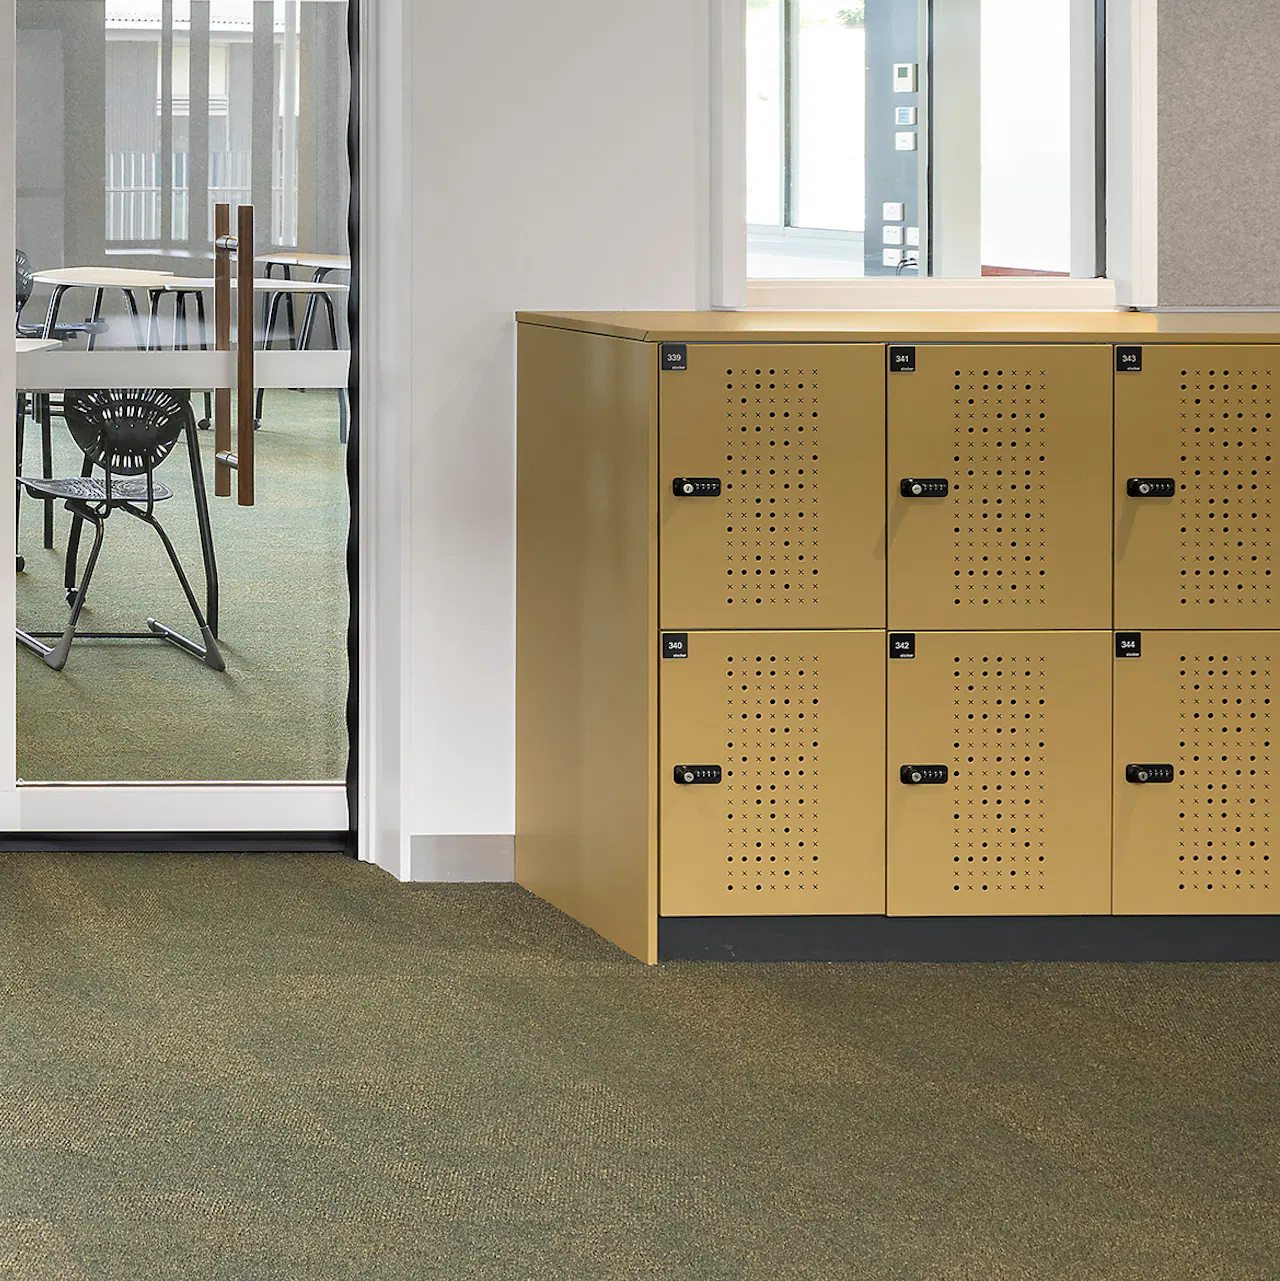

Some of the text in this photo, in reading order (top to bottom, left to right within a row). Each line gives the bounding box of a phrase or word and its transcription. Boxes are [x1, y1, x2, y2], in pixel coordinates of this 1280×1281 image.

[667, 353, 682, 362] 339
[895, 355, 909, 363] 341
[1121, 354, 1137, 363] 343
[668, 641, 683, 650] 340
[895, 641, 910, 650] 342
[1121, 640, 1136, 649] 344
